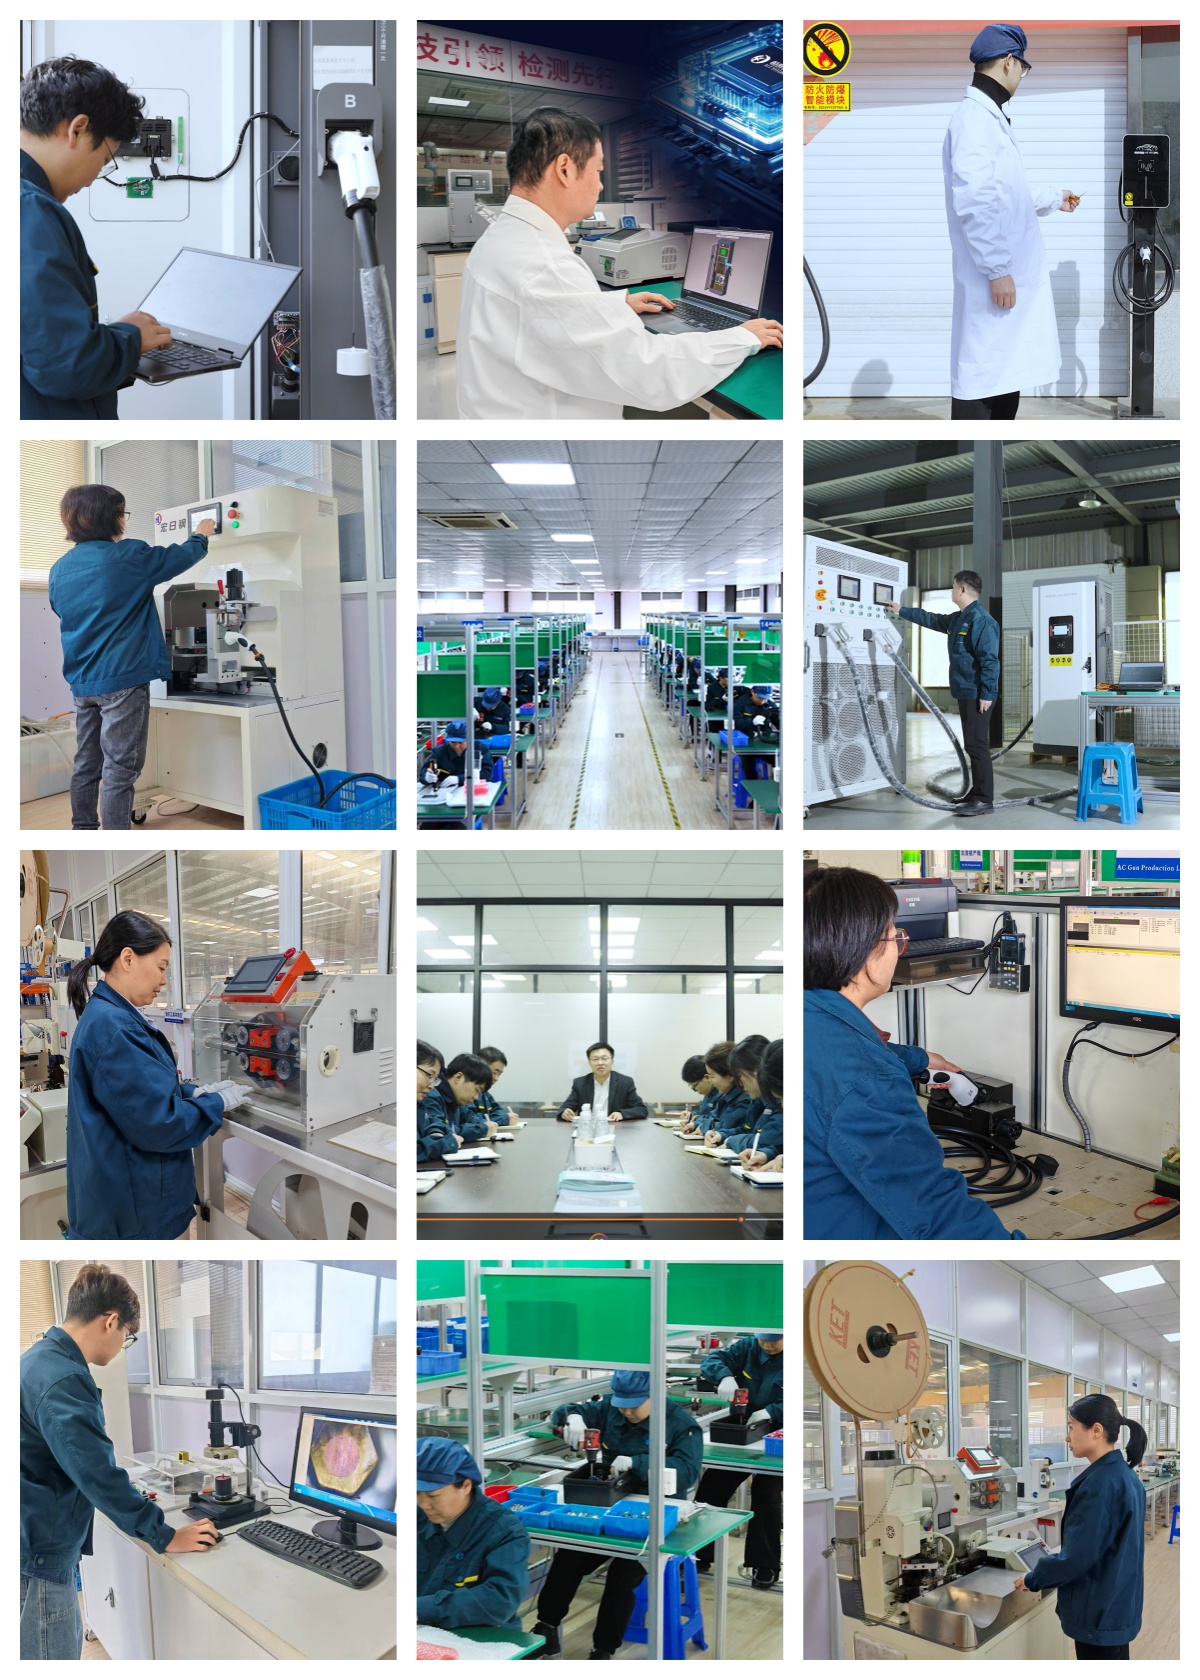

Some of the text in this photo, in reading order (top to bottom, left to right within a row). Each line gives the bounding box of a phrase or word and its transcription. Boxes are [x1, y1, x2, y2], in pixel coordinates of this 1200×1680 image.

[517, 50, 617, 90] 检测先行
[805, 85, 846, 95] 防火防爆
[344, 94, 357, 108] B
[805, 95, 846, 105] 智能模块
[1141, 864, 1175, 872] Production
[828, 1297, 847, 1350] KET
[907, 1339, 921, 1379] KET
